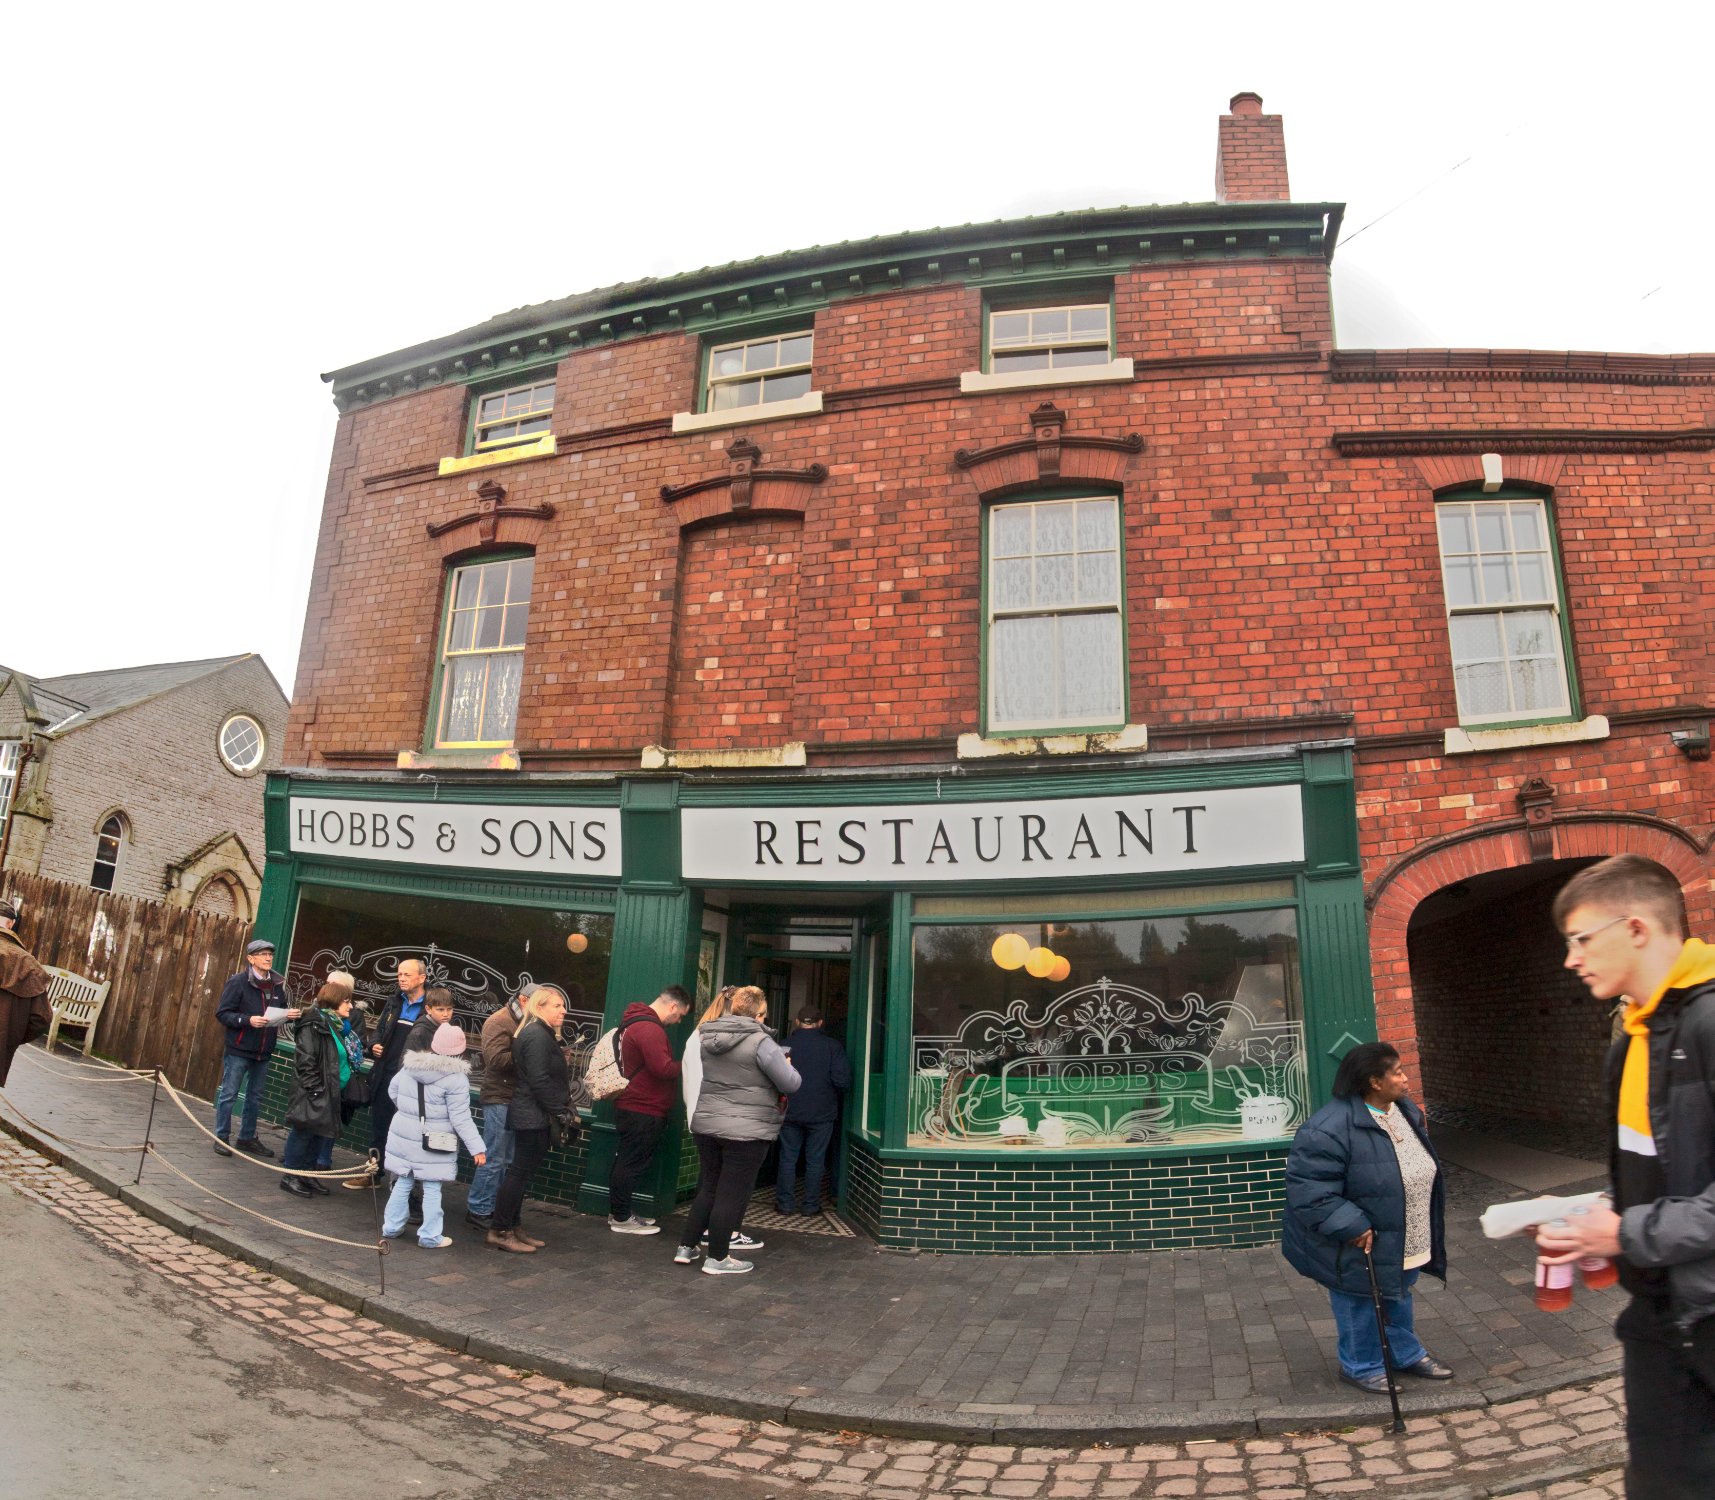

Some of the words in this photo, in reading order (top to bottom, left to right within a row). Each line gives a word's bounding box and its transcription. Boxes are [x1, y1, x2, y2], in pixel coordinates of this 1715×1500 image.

[297, 808, 415, 850] HOBBS
[435, 822, 456, 853] &
[480, 818, 606, 861] SONS
[753, 805, 1207, 866] RESTAURANT
[1026, 1056, 1188, 1095] HOBBS
